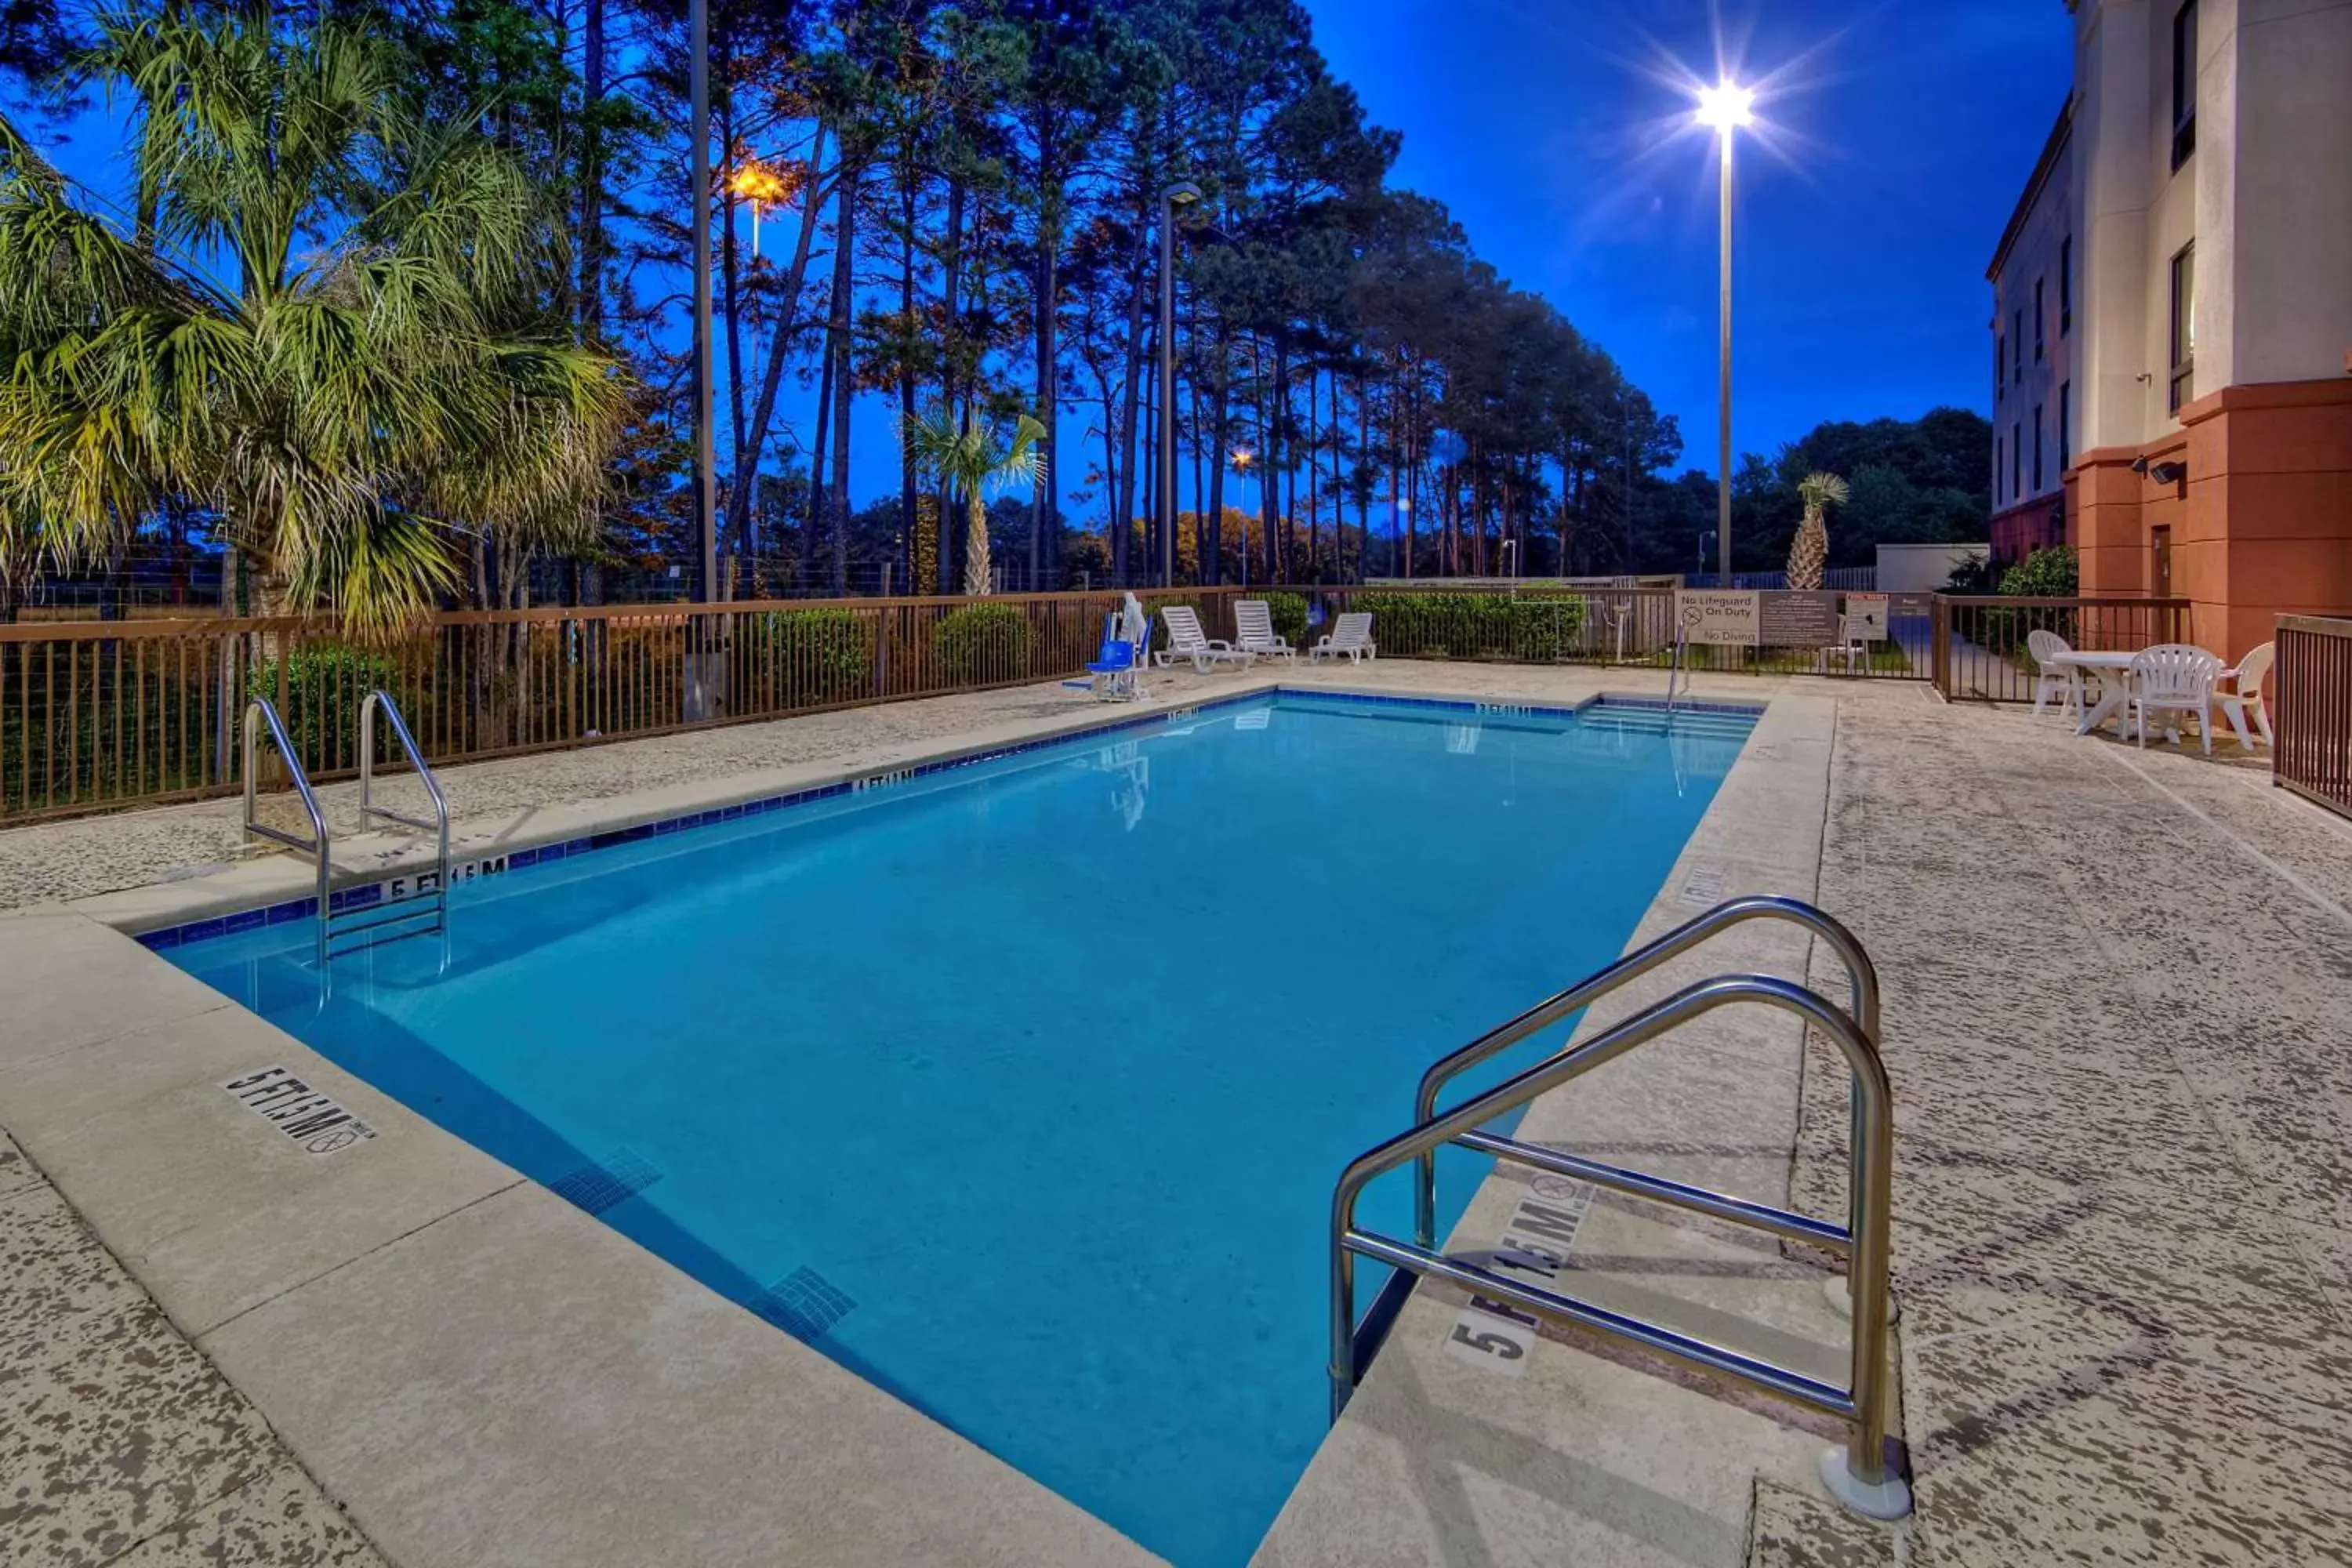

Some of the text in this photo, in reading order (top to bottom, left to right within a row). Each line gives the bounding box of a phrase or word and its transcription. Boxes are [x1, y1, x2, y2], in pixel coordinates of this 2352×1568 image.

[1700, 597, 1751, 607] Lifeguard
[1725, 608, 1751, 618] Duty
[1704, 631, 1755, 643] No Diving
[391, 879, 405, 898] 5
[226, 1068, 286, 1090] 5
[239, 1078, 310, 1107] FT
[1451, 1323, 1524, 1360] 5
